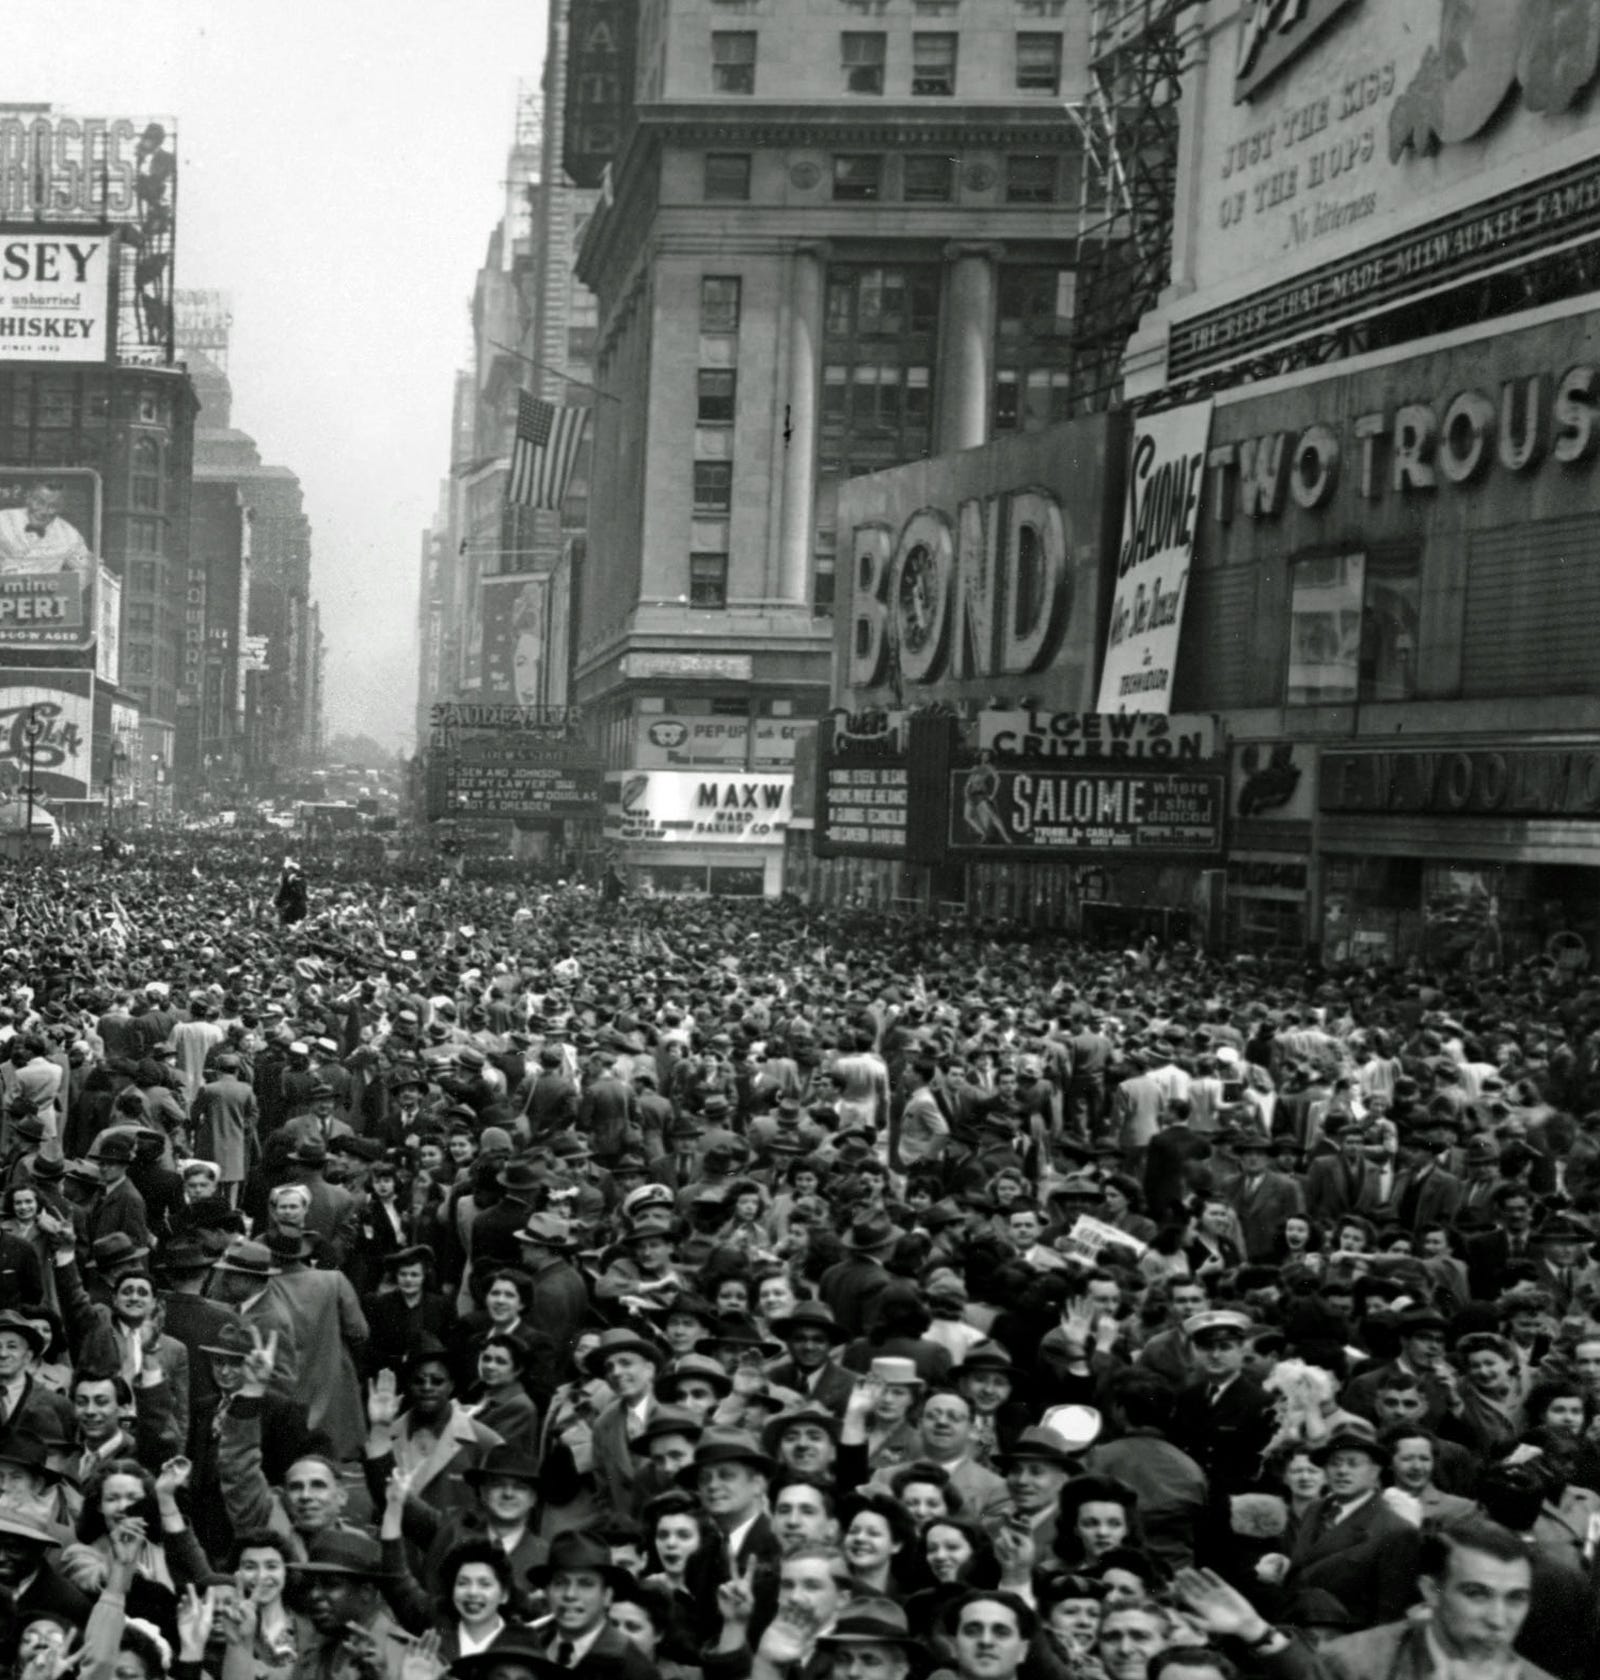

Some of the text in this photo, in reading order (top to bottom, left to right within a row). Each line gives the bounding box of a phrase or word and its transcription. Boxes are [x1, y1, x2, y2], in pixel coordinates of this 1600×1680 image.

[1283, 96, 1332, 148] THE
[0, 118, 134, 211] ROSES
[1219, 129, 1376, 229] OF THE HOPS
[1332, 258, 1385, 297] MADE
[1400, 206, 1522, 275] MILWAUKEE
[11, 293, 80, 309] unhurried
[1208, 423, 1342, 523] TWO
[1120, 434, 1202, 578] SALOME
[4, 577, 61, 593] mine
[848, 485, 1068, 690] BOND
[45, 632, 79, 642] AGED
[993, 731, 1202, 758] CRITERION
[1030, 711, 1169, 739] LOEW'S
[715, 811, 754, 823] WARD
[1012, 774, 1208, 832] SALOME where
[1166, 795, 1198, 812] she
[697, 822, 743, 835] BAKING
